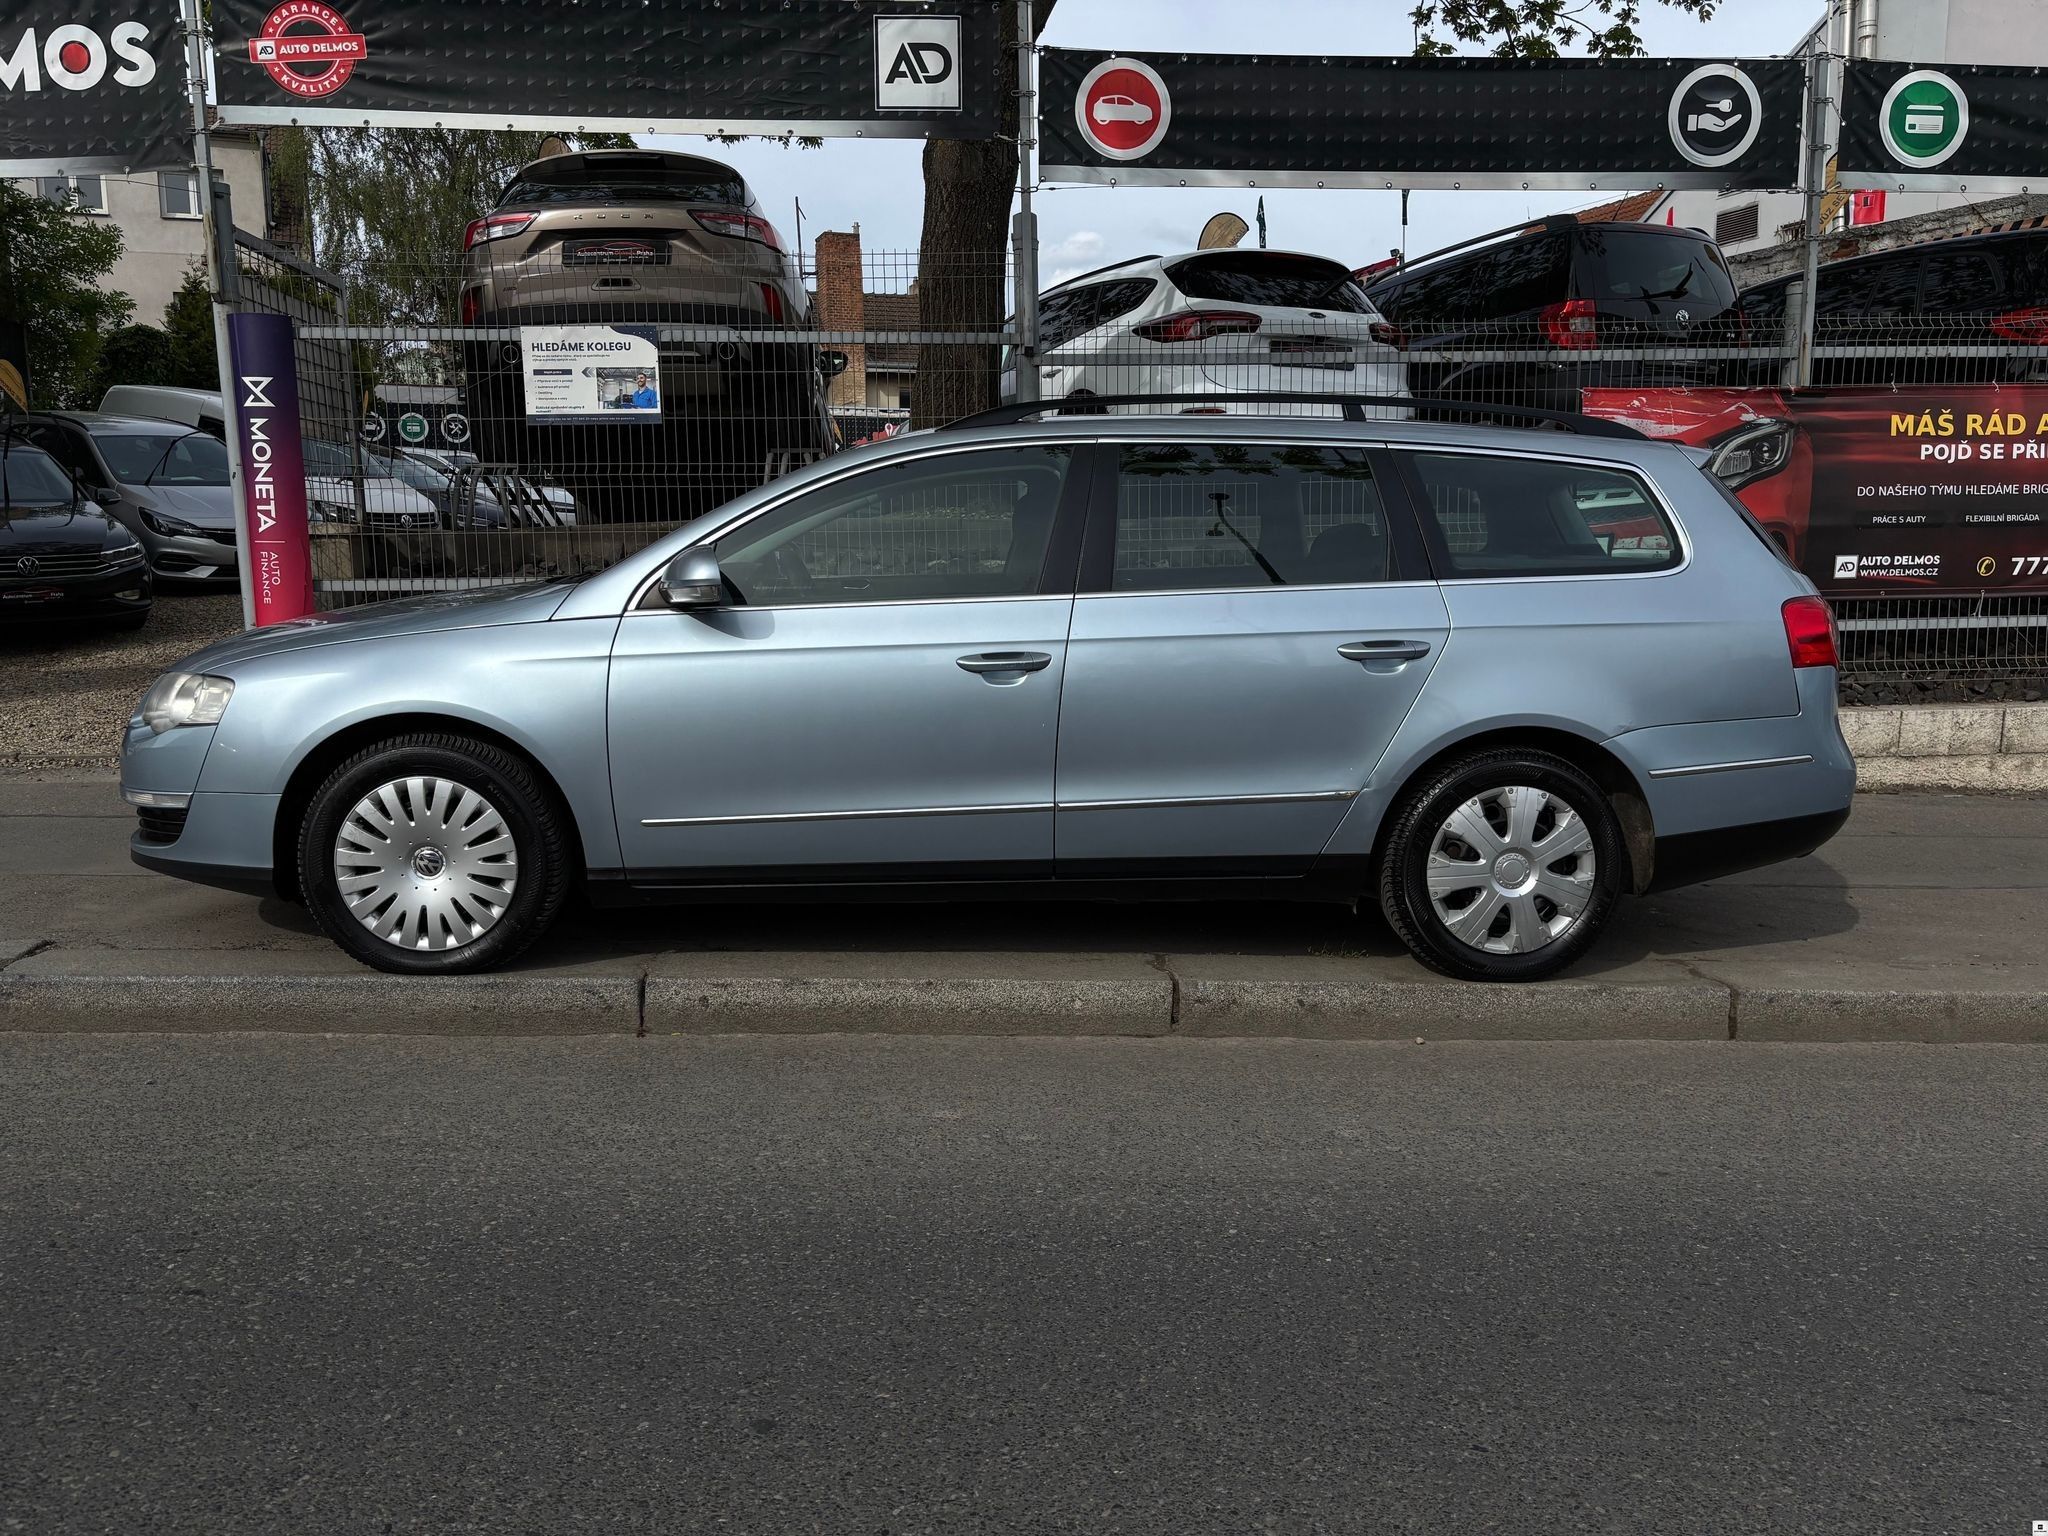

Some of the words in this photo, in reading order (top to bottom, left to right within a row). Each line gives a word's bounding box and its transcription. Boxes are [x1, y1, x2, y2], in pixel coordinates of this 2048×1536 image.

[272, 1, 340, 27] GARANCE
[0, 21, 157, 93] MOS
[279, 43, 310, 56] AUTO
[312, 40, 359, 54] DELMOS
[884, 42, 953, 85] AD
[280, 73, 341, 95] KVALITY
[531, 339, 585, 352] HLEDÁME
[587, 341, 632, 352] KOLEGU
[1890, 408, 1955, 437] MÁŠ
[1966, 408, 2027, 436] RÁD
[1920, 440, 1972, 464] POJĎ
[1979, 443, 2004, 460] SE
[2012, 439, 2048, 459] PŘI
[249, 417, 278, 534] MONETA
[1857, 486, 1875, 497] DO
[1880, 483, 1927, 497] NAŠEHO
[1930, 483, 1962, 496] TÝMU
[1965, 482, 2020, 495] HLEDÁME
[1872, 514, 1897, 524] PRÁCE
[1905, 515, 1927, 523] AUTY
[1965, 513, 2005, 522] FLEXIBILNÍ
[2006, 512, 2040, 522] BRIGÁDA
[269, 551, 281, 587] AUTO
[1859, 555, 1891, 566] AUTO
[1893, 554, 1941, 565] DELMOS
[260, 551, 272, 605] FINANCE
[1859, 567, 1939, 577] WWW.DELMOS.CZ
